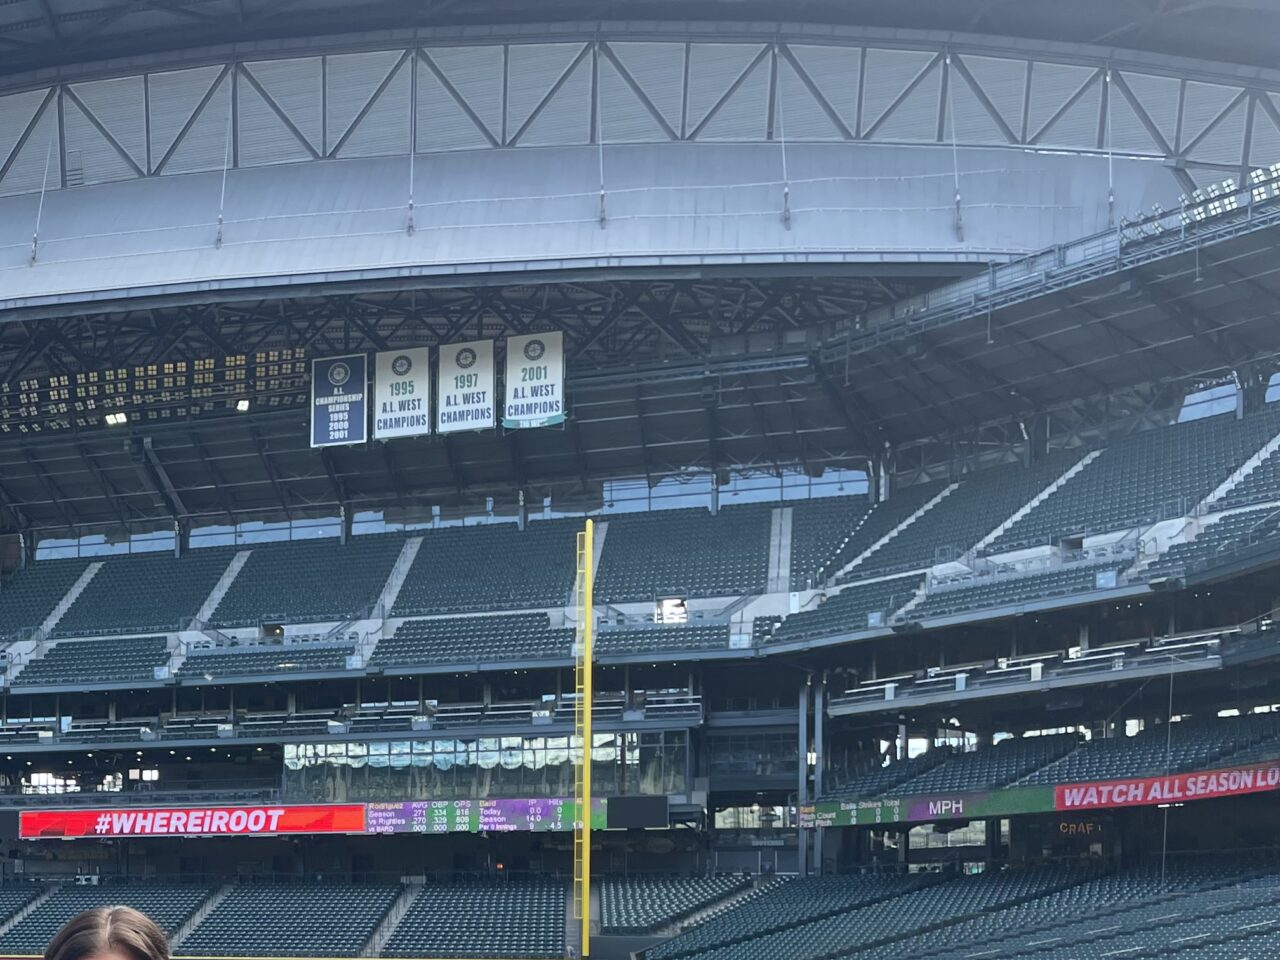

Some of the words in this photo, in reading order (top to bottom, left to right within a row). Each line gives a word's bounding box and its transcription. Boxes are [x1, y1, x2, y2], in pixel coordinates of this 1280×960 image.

[454, 373, 478, 389] 1997
[521, 365, 547, 382] 2001
[389, 380, 415, 396] 1995
[513, 387, 528, 399] A.L.
[531, 383, 556, 398] WEST
[316, 393, 363, 406] CHAMPIONSHIP
[382, 401, 397, 414] A.L.
[398, 398, 422, 412] WEST
[446, 394, 460, 407] A.L.
[462, 391, 486, 405] WEST
[328, 403, 350, 412] SERIES
[440, 407, 492, 424] CHAMPIONS
[507, 400, 560, 417] CHAMPIONS
[329, 421, 349, 430] 2000
[377, 414, 427, 431] CHAMPIONS
[329, 430, 348, 439] 2001
[1064, 783, 1144, 807] WATCH
[1147, 779, 1183, 800] ALL
[1186, 770, 1253, 796] SEASON
[1256, 767, 1280, 787] LO
[858, 800, 882, 809] Strikes
[883, 798, 900, 807] Total
[929, 800, 963, 815] MPH
[480, 808, 501, 816] Today
[817, 811, 836, 820] Count
[95, 809, 284, 834] #WHEREiROOT
[1059, 822, 1102, 835] CRAF
